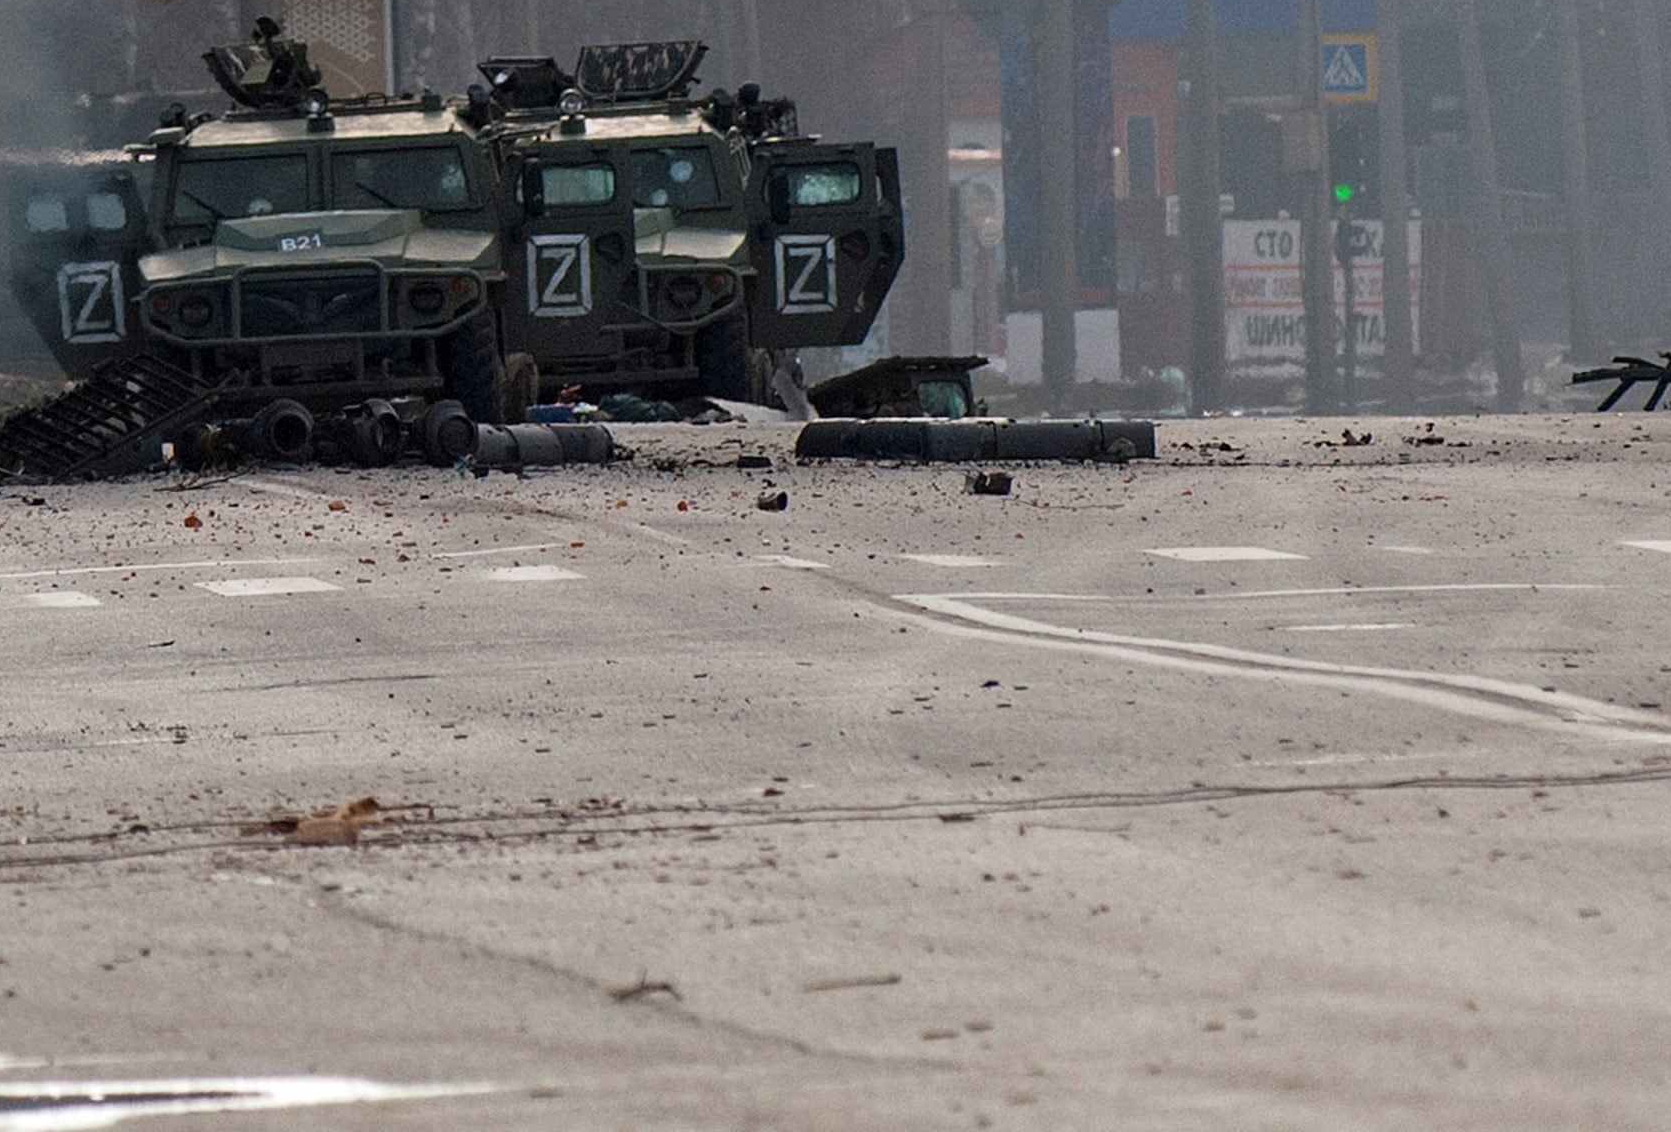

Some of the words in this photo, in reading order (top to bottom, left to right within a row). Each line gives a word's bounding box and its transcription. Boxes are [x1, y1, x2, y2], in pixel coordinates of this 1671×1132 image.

[281, 233, 321, 251] B21
[1254, 230, 1293, 258] СТО
[541, 247, 577, 303] Z
[788, 246, 825, 302] Z
[70, 273, 111, 332] Z
